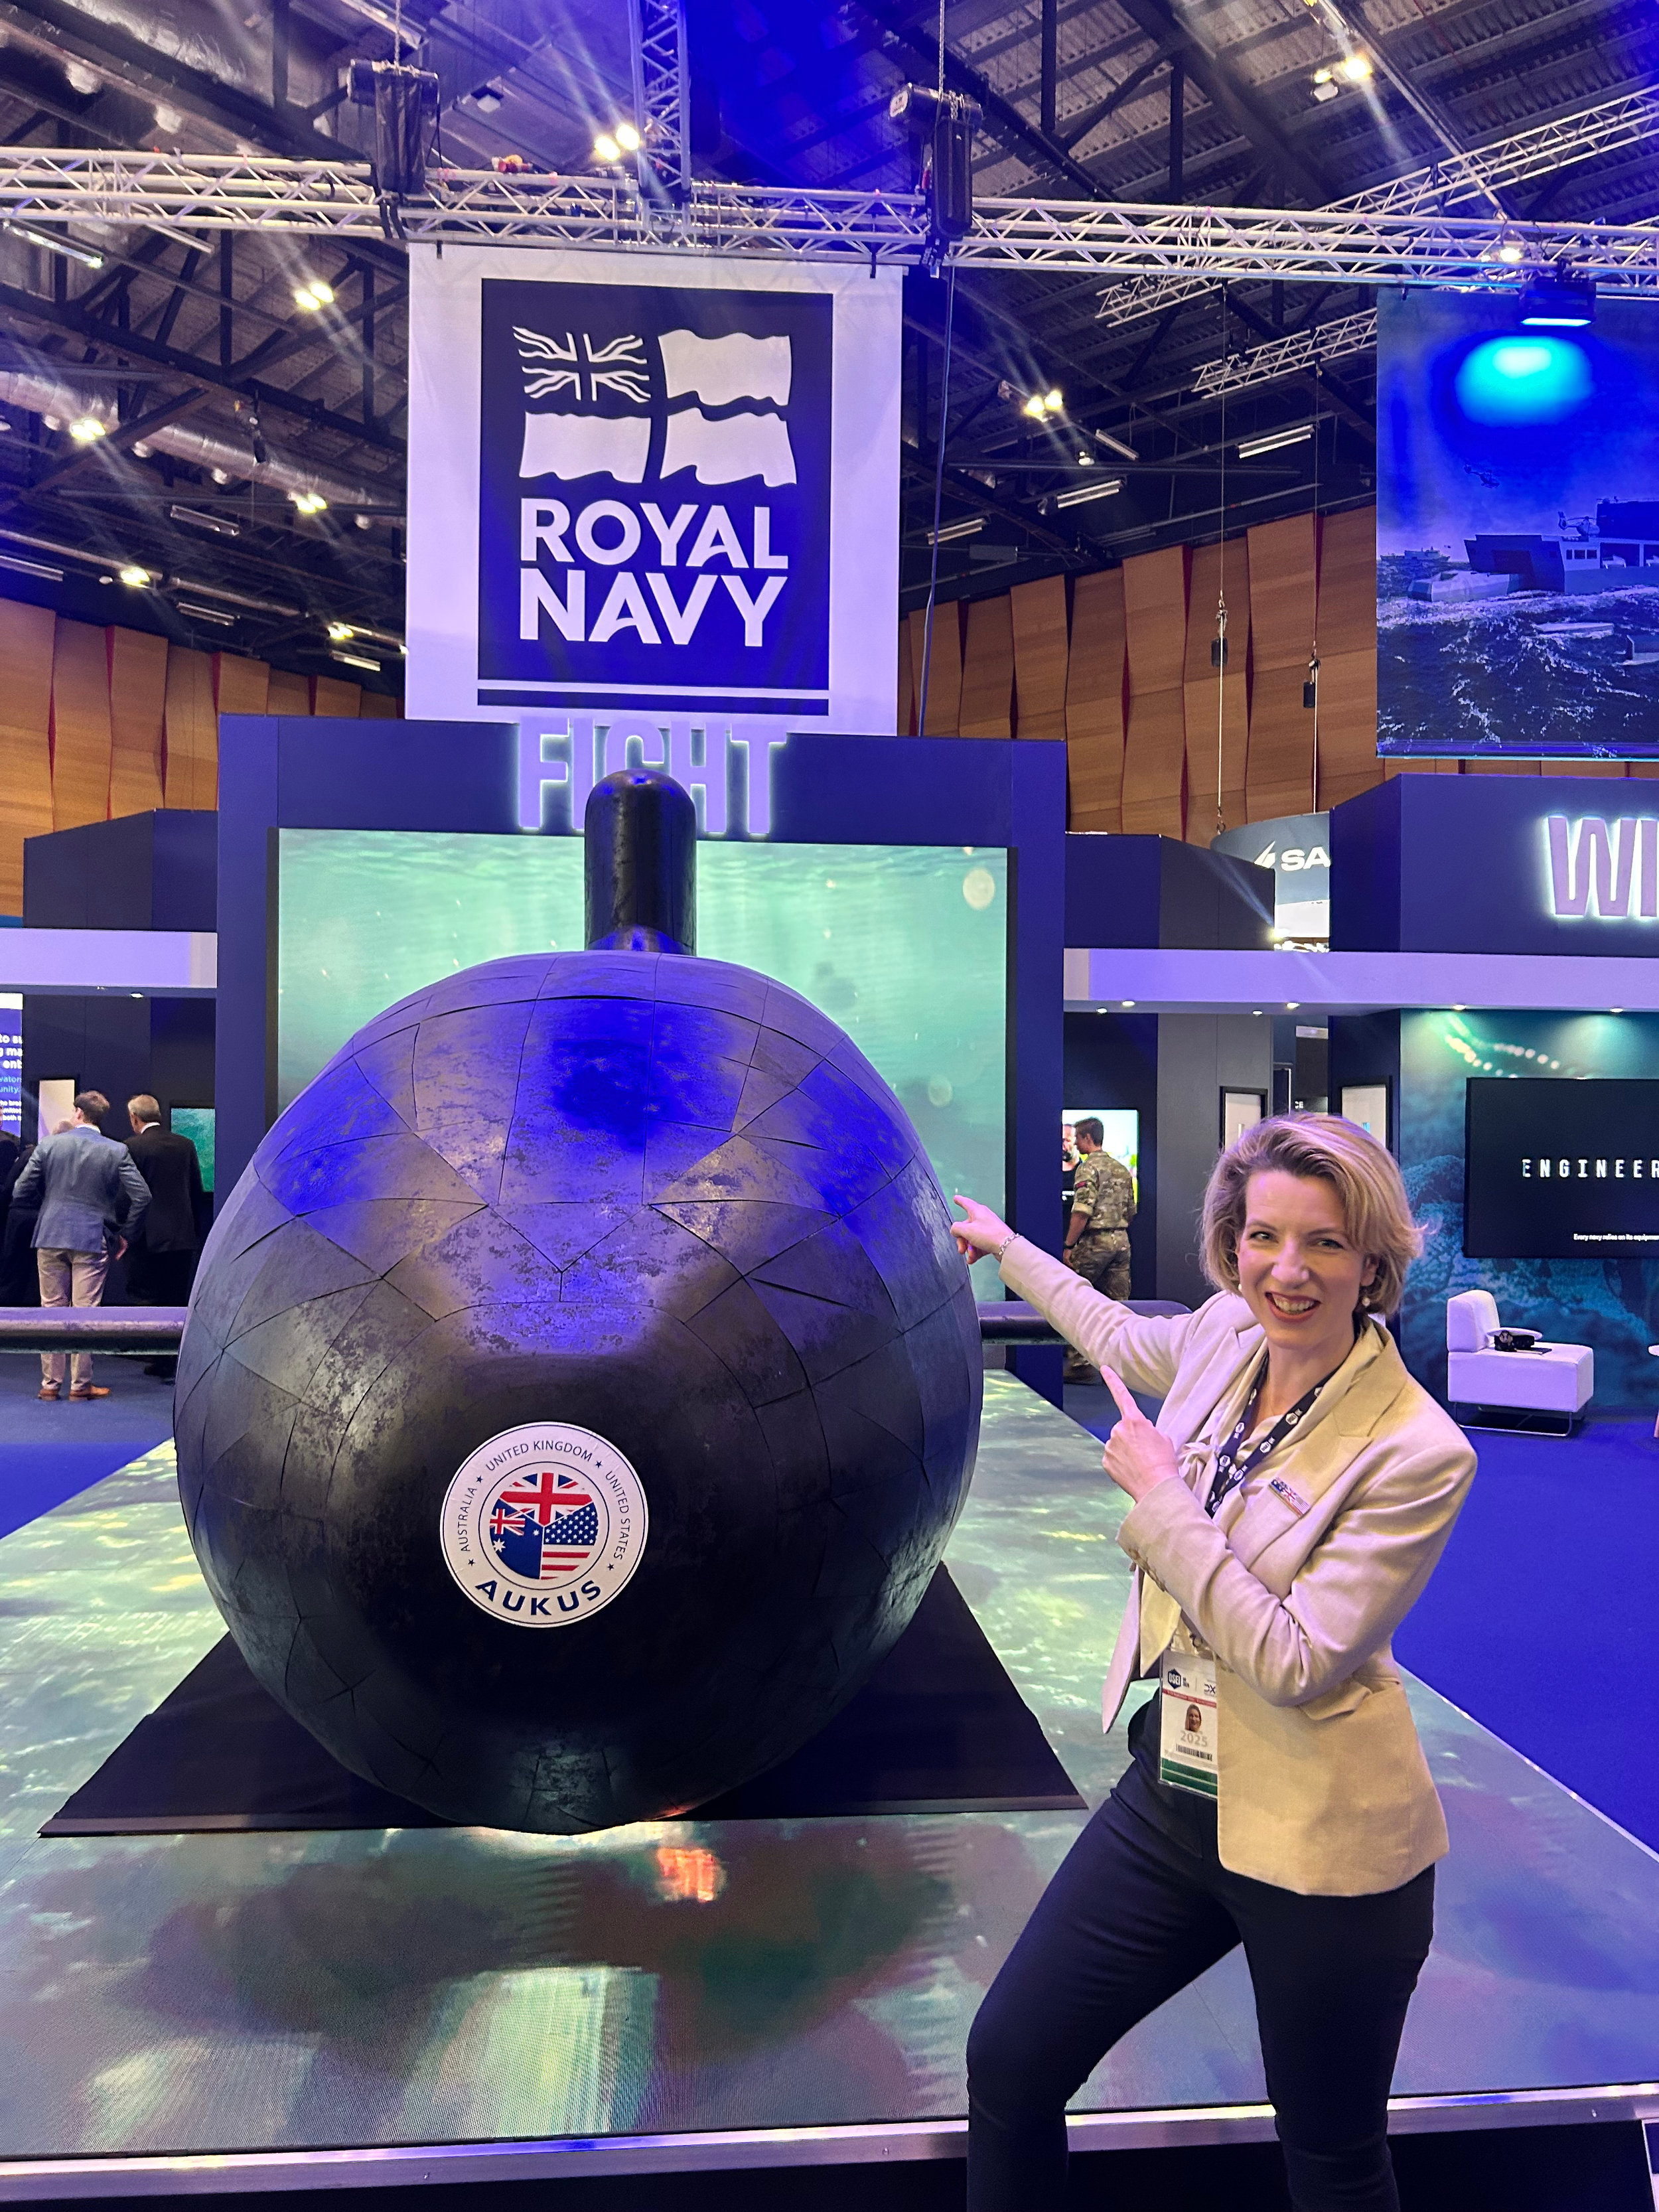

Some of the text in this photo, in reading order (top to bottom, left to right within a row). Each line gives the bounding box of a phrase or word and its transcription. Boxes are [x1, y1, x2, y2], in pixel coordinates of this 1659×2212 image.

[521, 498, 788, 569] ROYAL
[520, 568, 788, 647] NAVY
[1548, 816, 1658, 917] WI
[1522, 1159, 1659, 1178] ENGINEER
[457, 1440, 631, 1560] AUSTRALIA UNITED KINGDOM UNITED STATES
[475, 1580, 601, 1616] AUKUS
[1169, 1672, 1181, 1686] DSEI
[1180, 1730, 1208, 1747] 2025
